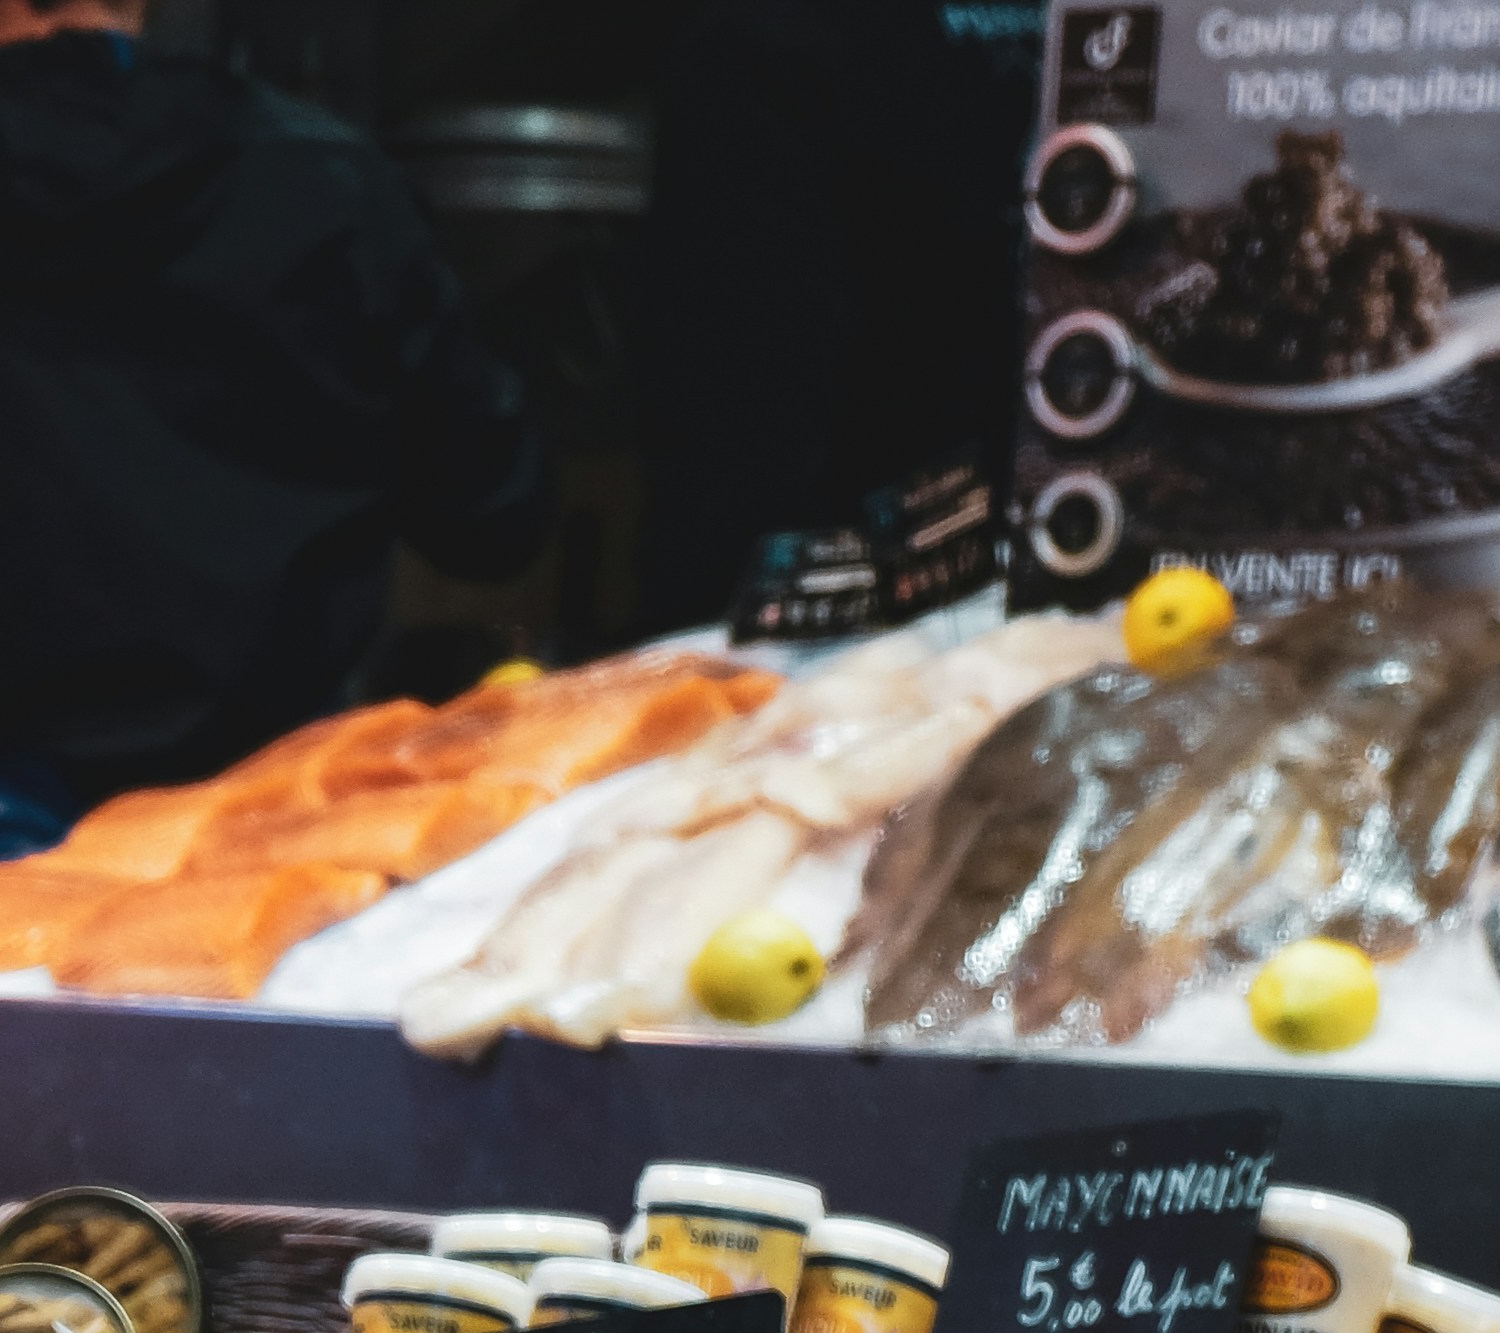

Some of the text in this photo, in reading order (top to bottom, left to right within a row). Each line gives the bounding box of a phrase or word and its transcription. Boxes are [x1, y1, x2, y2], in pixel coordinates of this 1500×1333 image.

[1203, 6, 1333, 59] Caviar
[1343, 4, 1402, 52] de
[1227, 71, 1336, 118] 100%
[689, 1227, 759, 1254] SAVEUR
